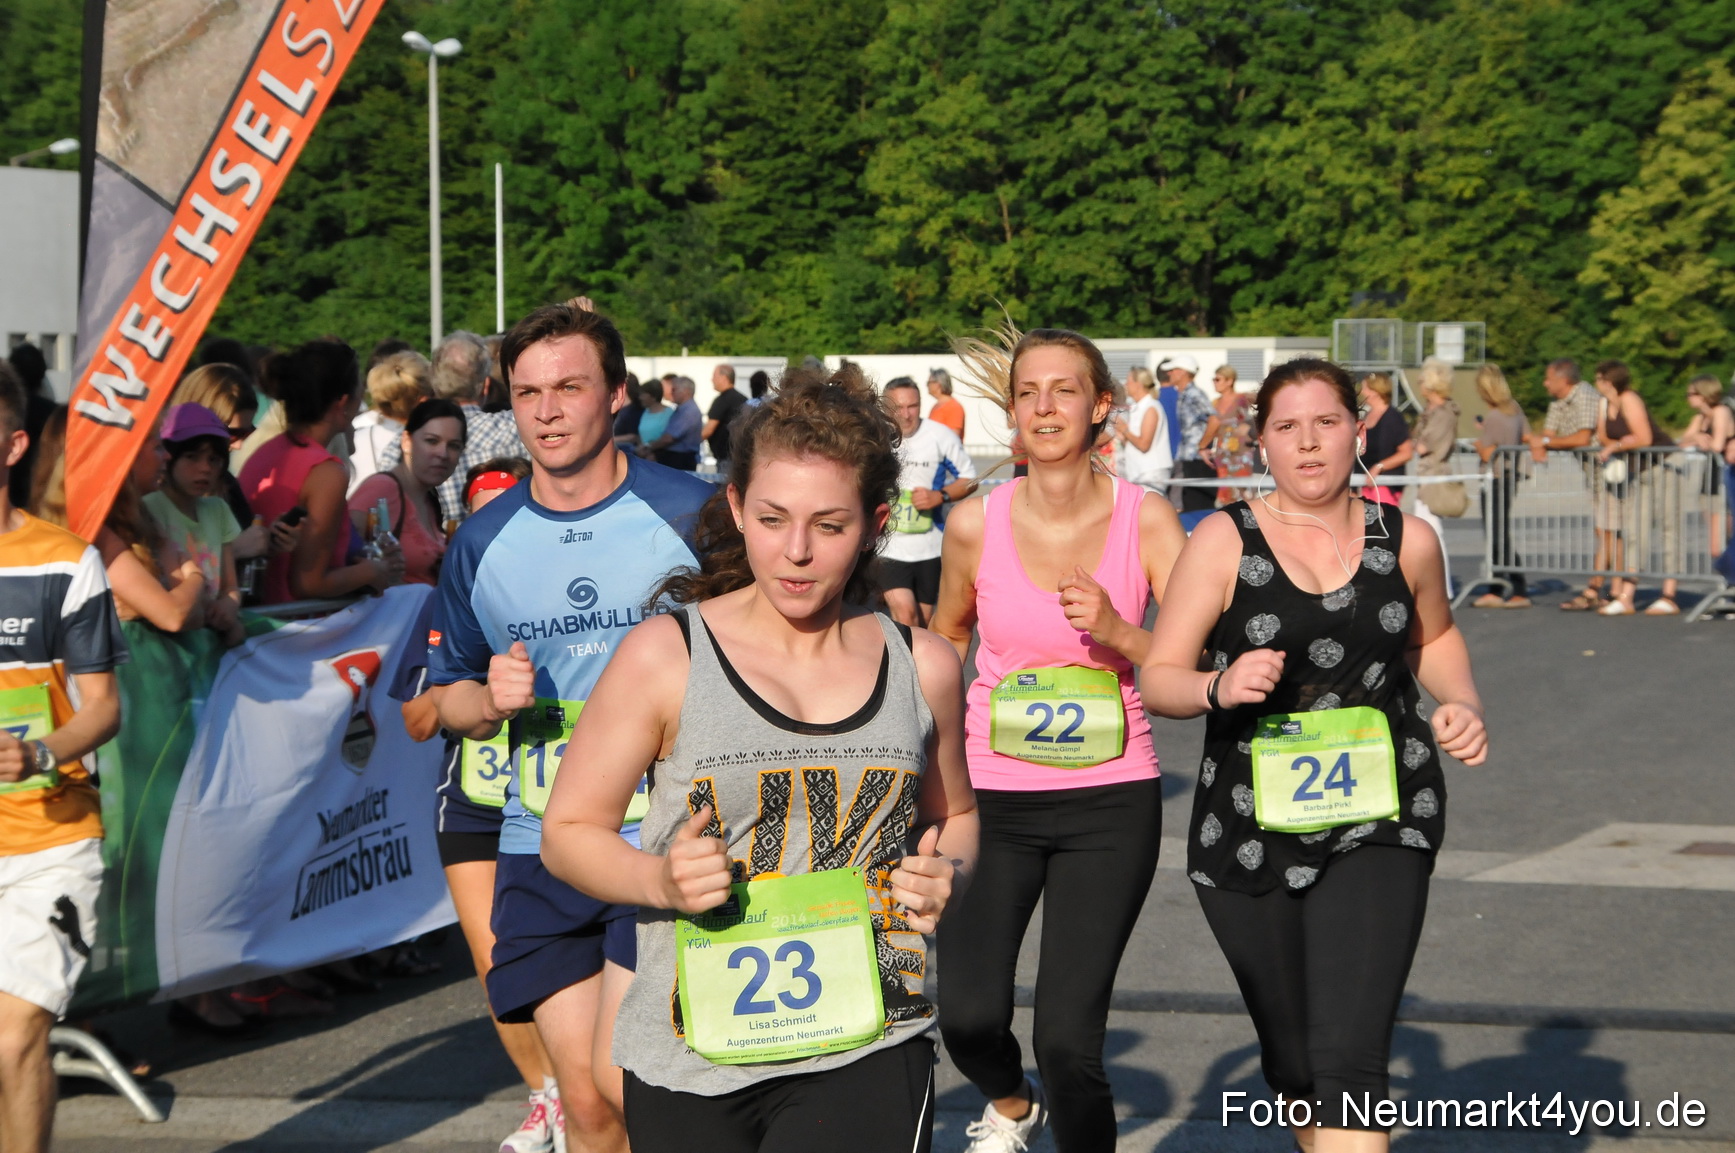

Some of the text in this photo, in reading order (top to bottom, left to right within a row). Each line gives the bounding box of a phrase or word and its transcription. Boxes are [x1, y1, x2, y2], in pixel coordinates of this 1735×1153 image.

[567, 641, 608, 657] TEAM
[1010, 683, 1055, 692] firmenlauf
[1024, 702, 1085, 744] 22
[1016, 752, 1063, 761] Augenzentrum
[1031, 744, 1081, 753] Melanie Gimpl
[1290, 752, 1358, 802] 24
[1304, 804, 1333, 812] Barbara
[1286, 810, 1370, 824] Augenzentrum Neumarkt
[289, 827, 413, 919] Lammsbräu
[702, 909, 768, 929] firmenlauf
[727, 939, 823, 1016] 23
[748, 1013, 817, 1030] Lisa Schmidt
[726, 1026, 844, 1047] Augenzentrum Neumarkt
